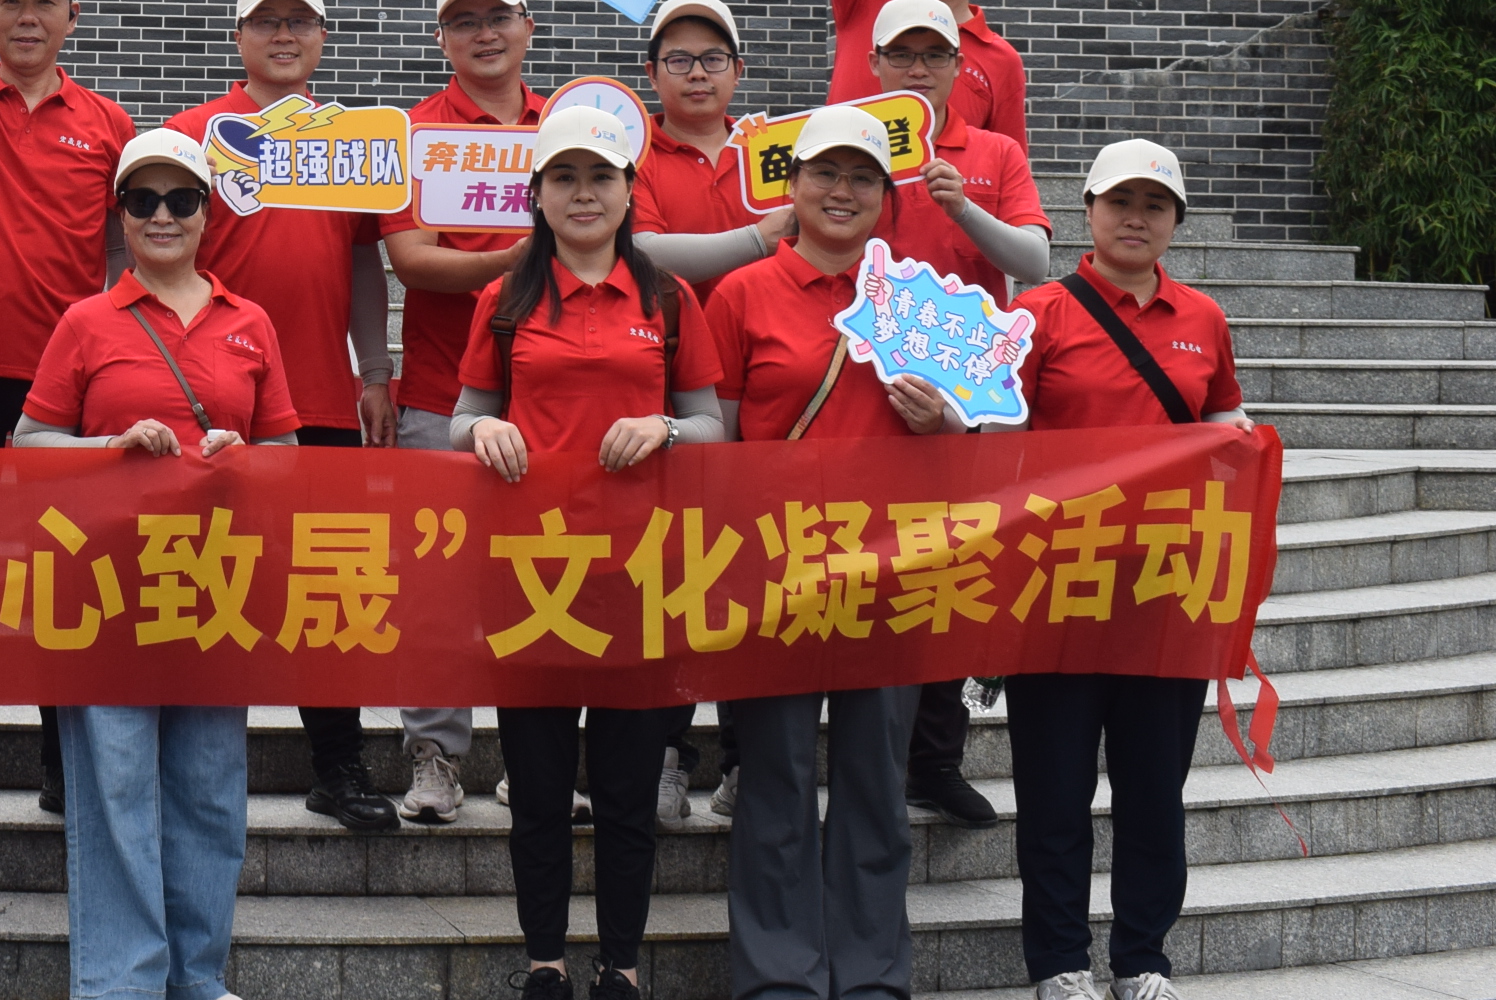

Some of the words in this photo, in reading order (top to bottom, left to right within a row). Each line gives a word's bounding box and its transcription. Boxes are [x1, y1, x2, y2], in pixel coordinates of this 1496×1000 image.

[259, 139, 405, 186] 超强战队
[460, 181, 534, 213] 未来
[893, 287, 990, 350] 青春不止
[872, 312, 993, 387] 梦想不停
